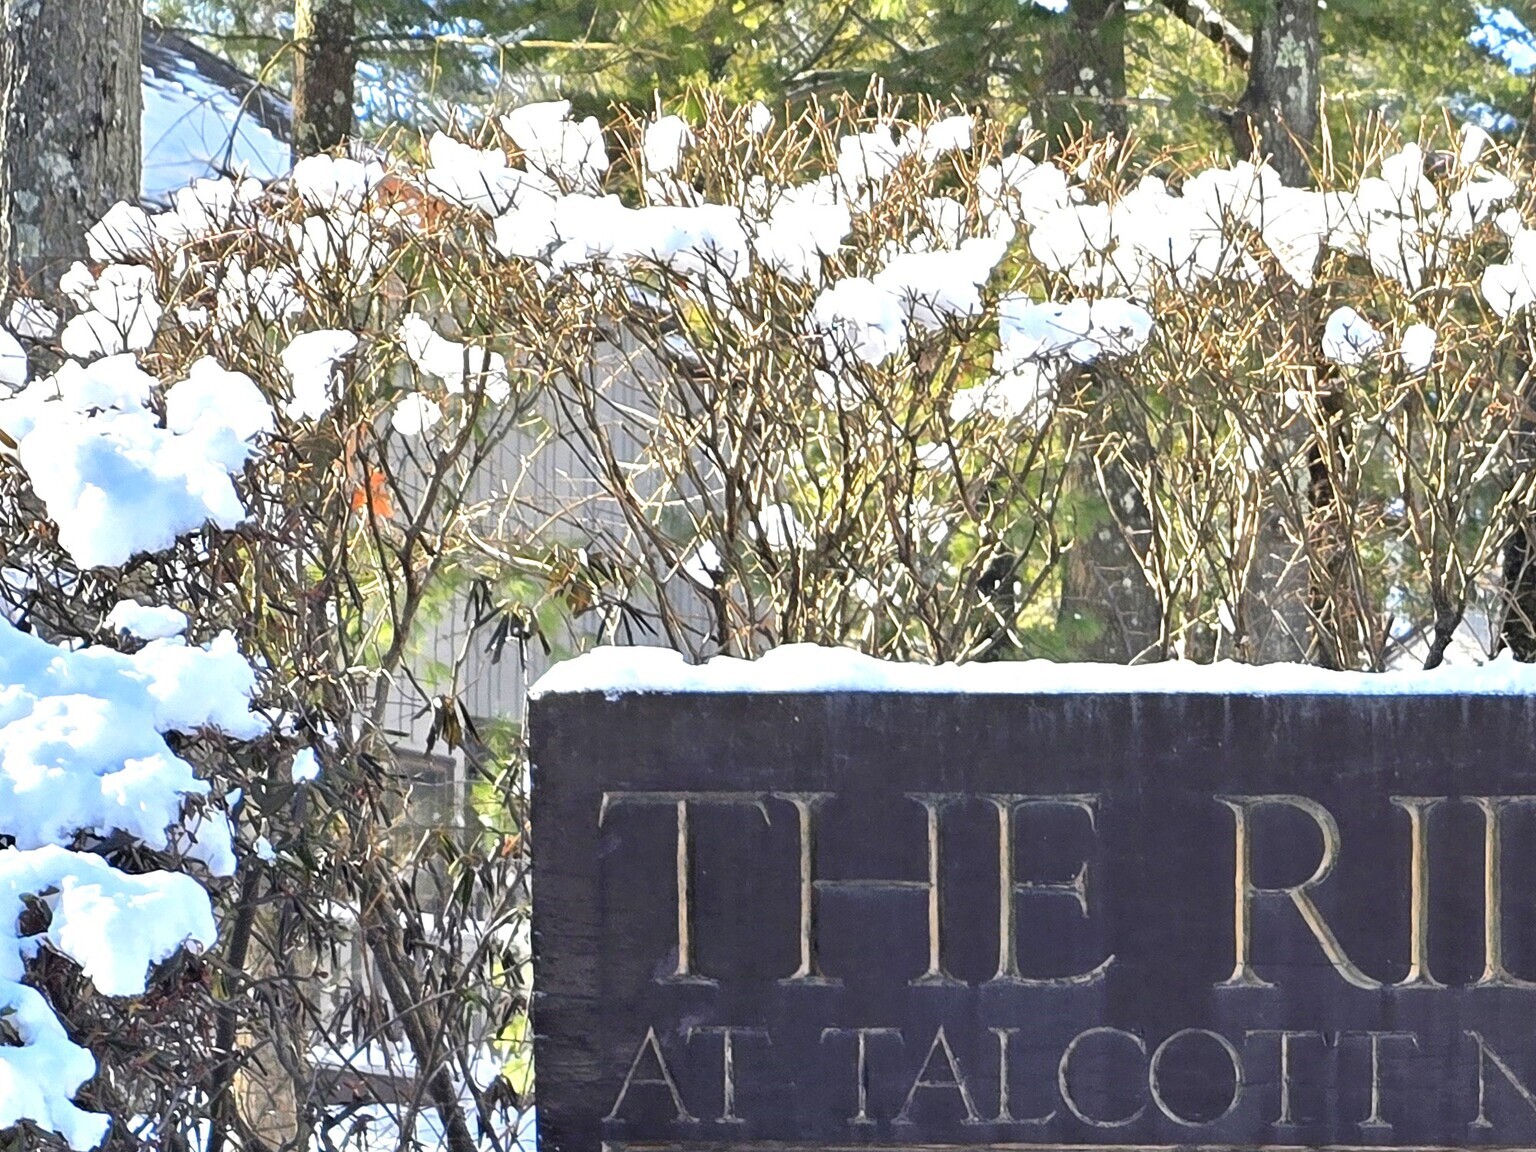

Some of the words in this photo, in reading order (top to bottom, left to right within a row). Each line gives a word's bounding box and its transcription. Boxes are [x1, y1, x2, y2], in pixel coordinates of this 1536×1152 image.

[598, 791, 1116, 987] THE
[601, 1025, 772, 1125] AT
[819, 1024, 1419, 1128] TALCOTT
